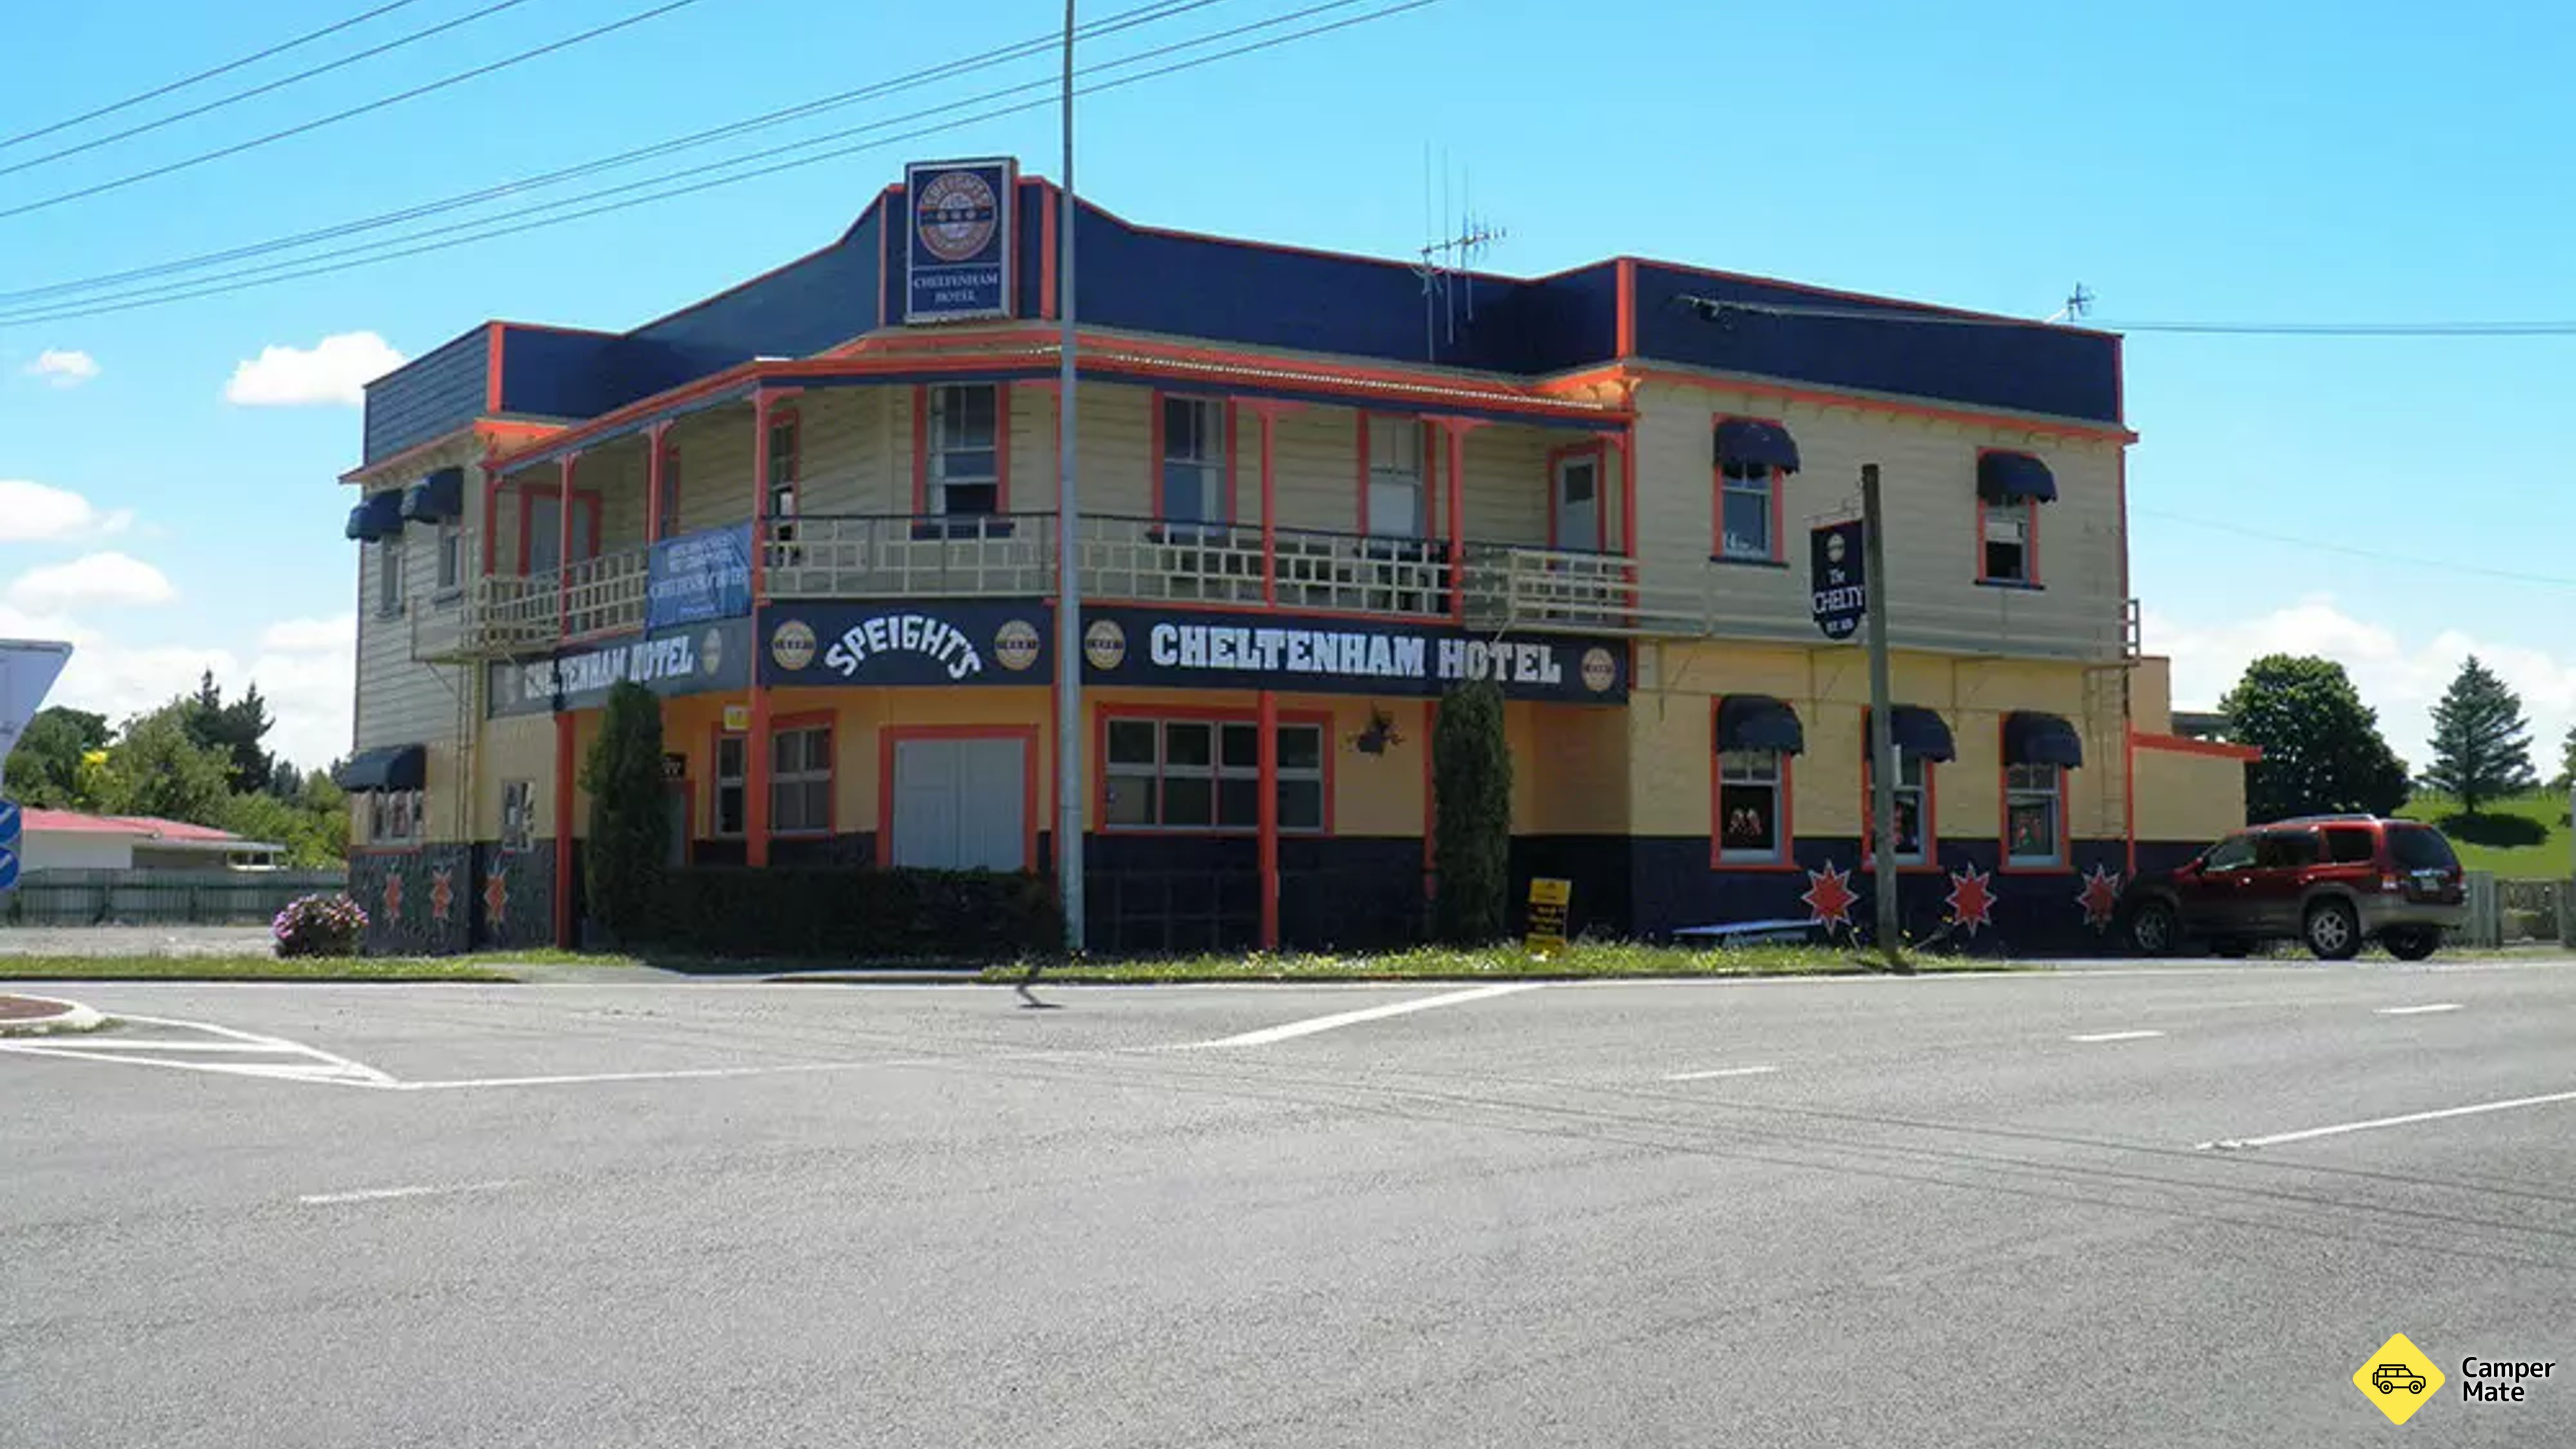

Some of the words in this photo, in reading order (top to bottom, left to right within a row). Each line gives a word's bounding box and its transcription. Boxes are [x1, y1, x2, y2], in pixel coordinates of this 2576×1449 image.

[913, 272, 998, 289] CHELTENHAM
[935, 290, 976, 303] HOTEL
[1813, 587, 1864, 613] CHELTY
[629, 635, 694, 681] HOTEL
[1151, 622, 1425, 676] CHELTENHAM
[1437, 638, 1562, 683] HOTEL
